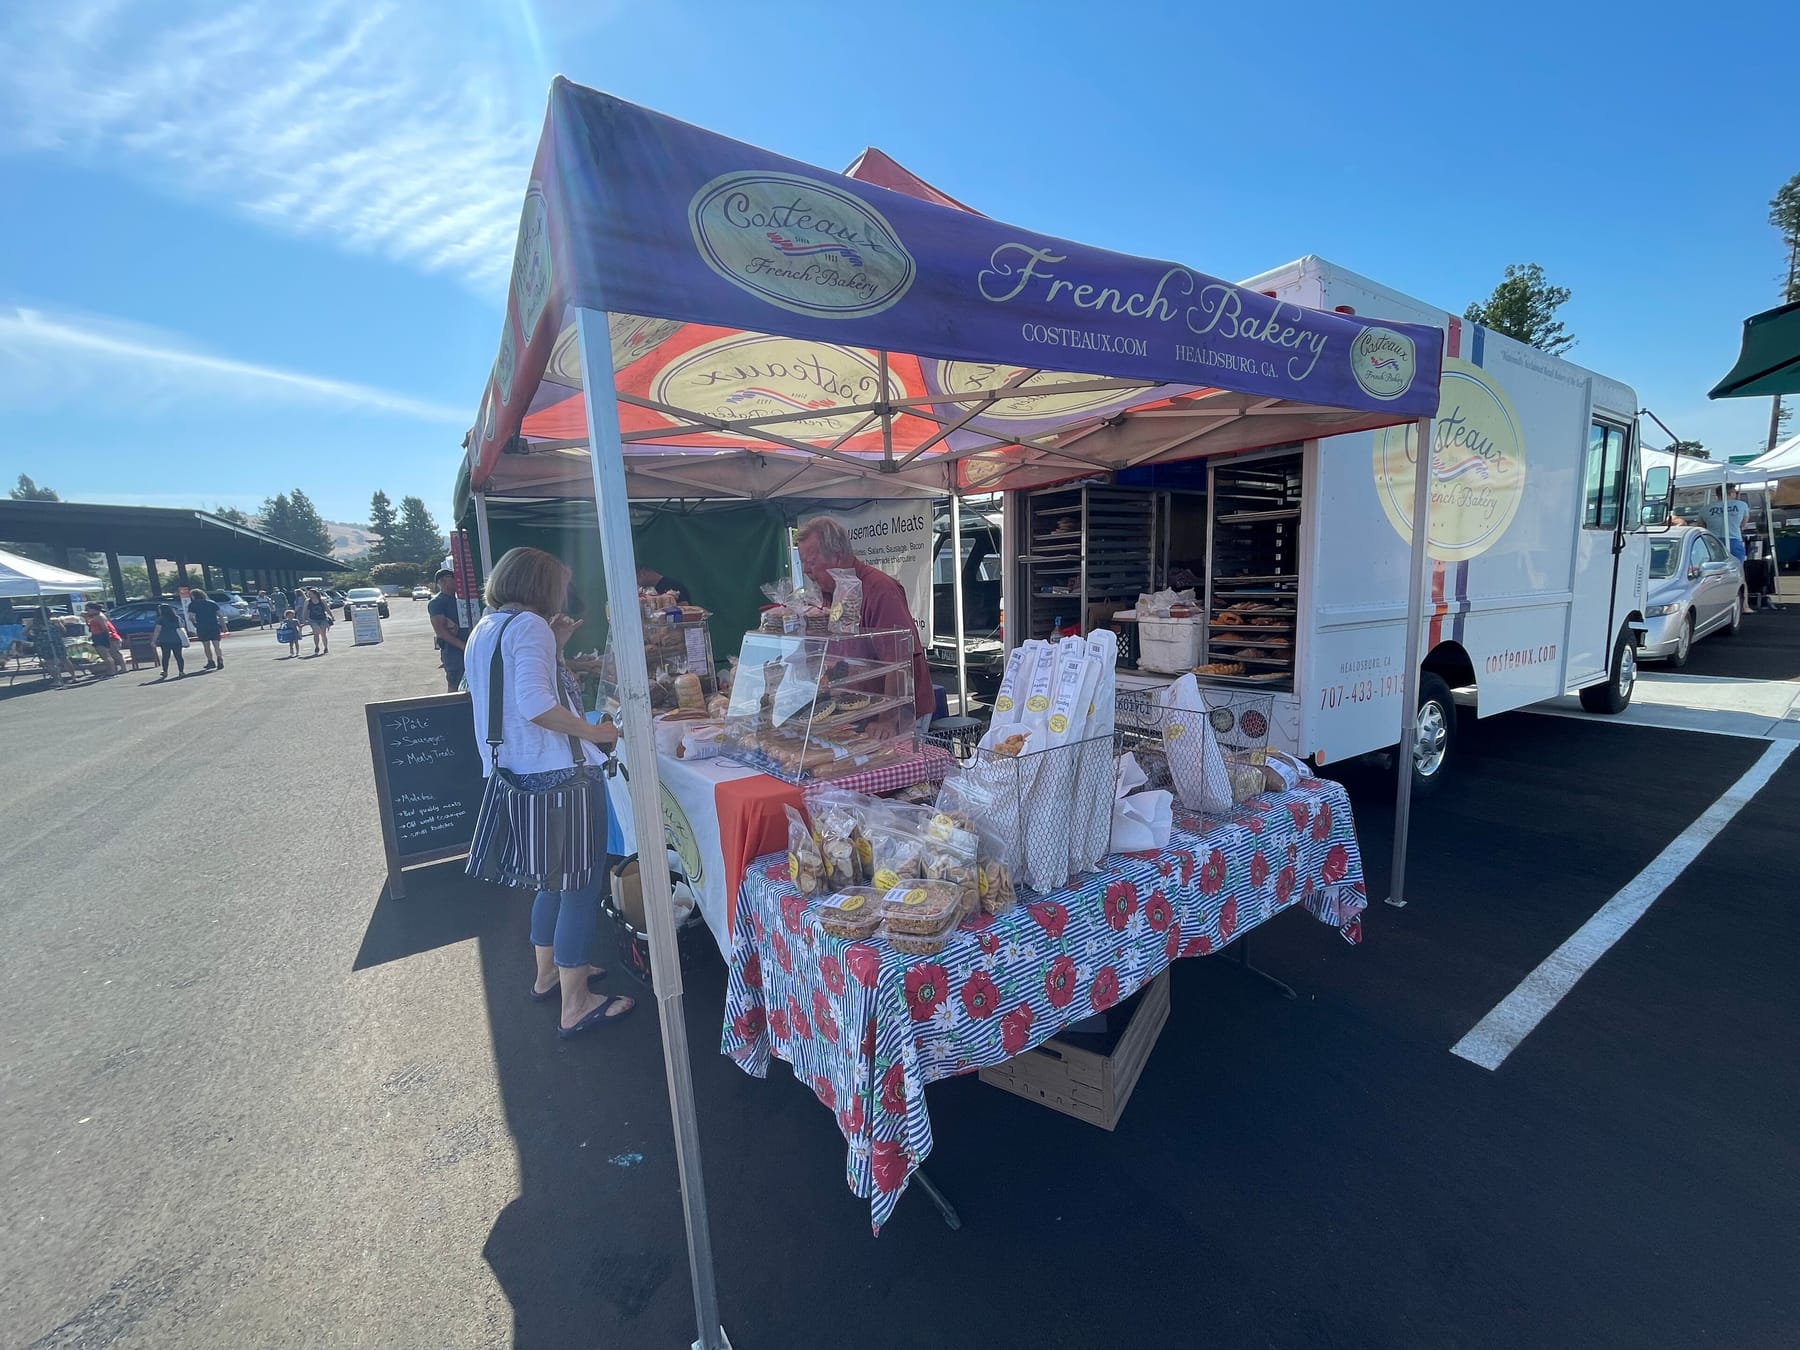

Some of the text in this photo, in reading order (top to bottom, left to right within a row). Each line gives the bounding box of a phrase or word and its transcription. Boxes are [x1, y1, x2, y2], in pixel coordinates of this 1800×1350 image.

[723, 192, 885, 252] Costeaux
[745, 257, 880, 300] French Bakery
[978, 242, 1328, 381] French Bakery
[1022, 323, 1148, 357] COSTEAUX.COM
[1360, 333, 1408, 361] Costeaux
[1405, 406, 1508, 473] Csteaux
[1457, 486, 1498, 520] Bakery
[848, 514, 924, 541] usemade Meats
[909, 542, 925, 551] Bacon
[1485, 643, 1557, 674] costeaux.com
